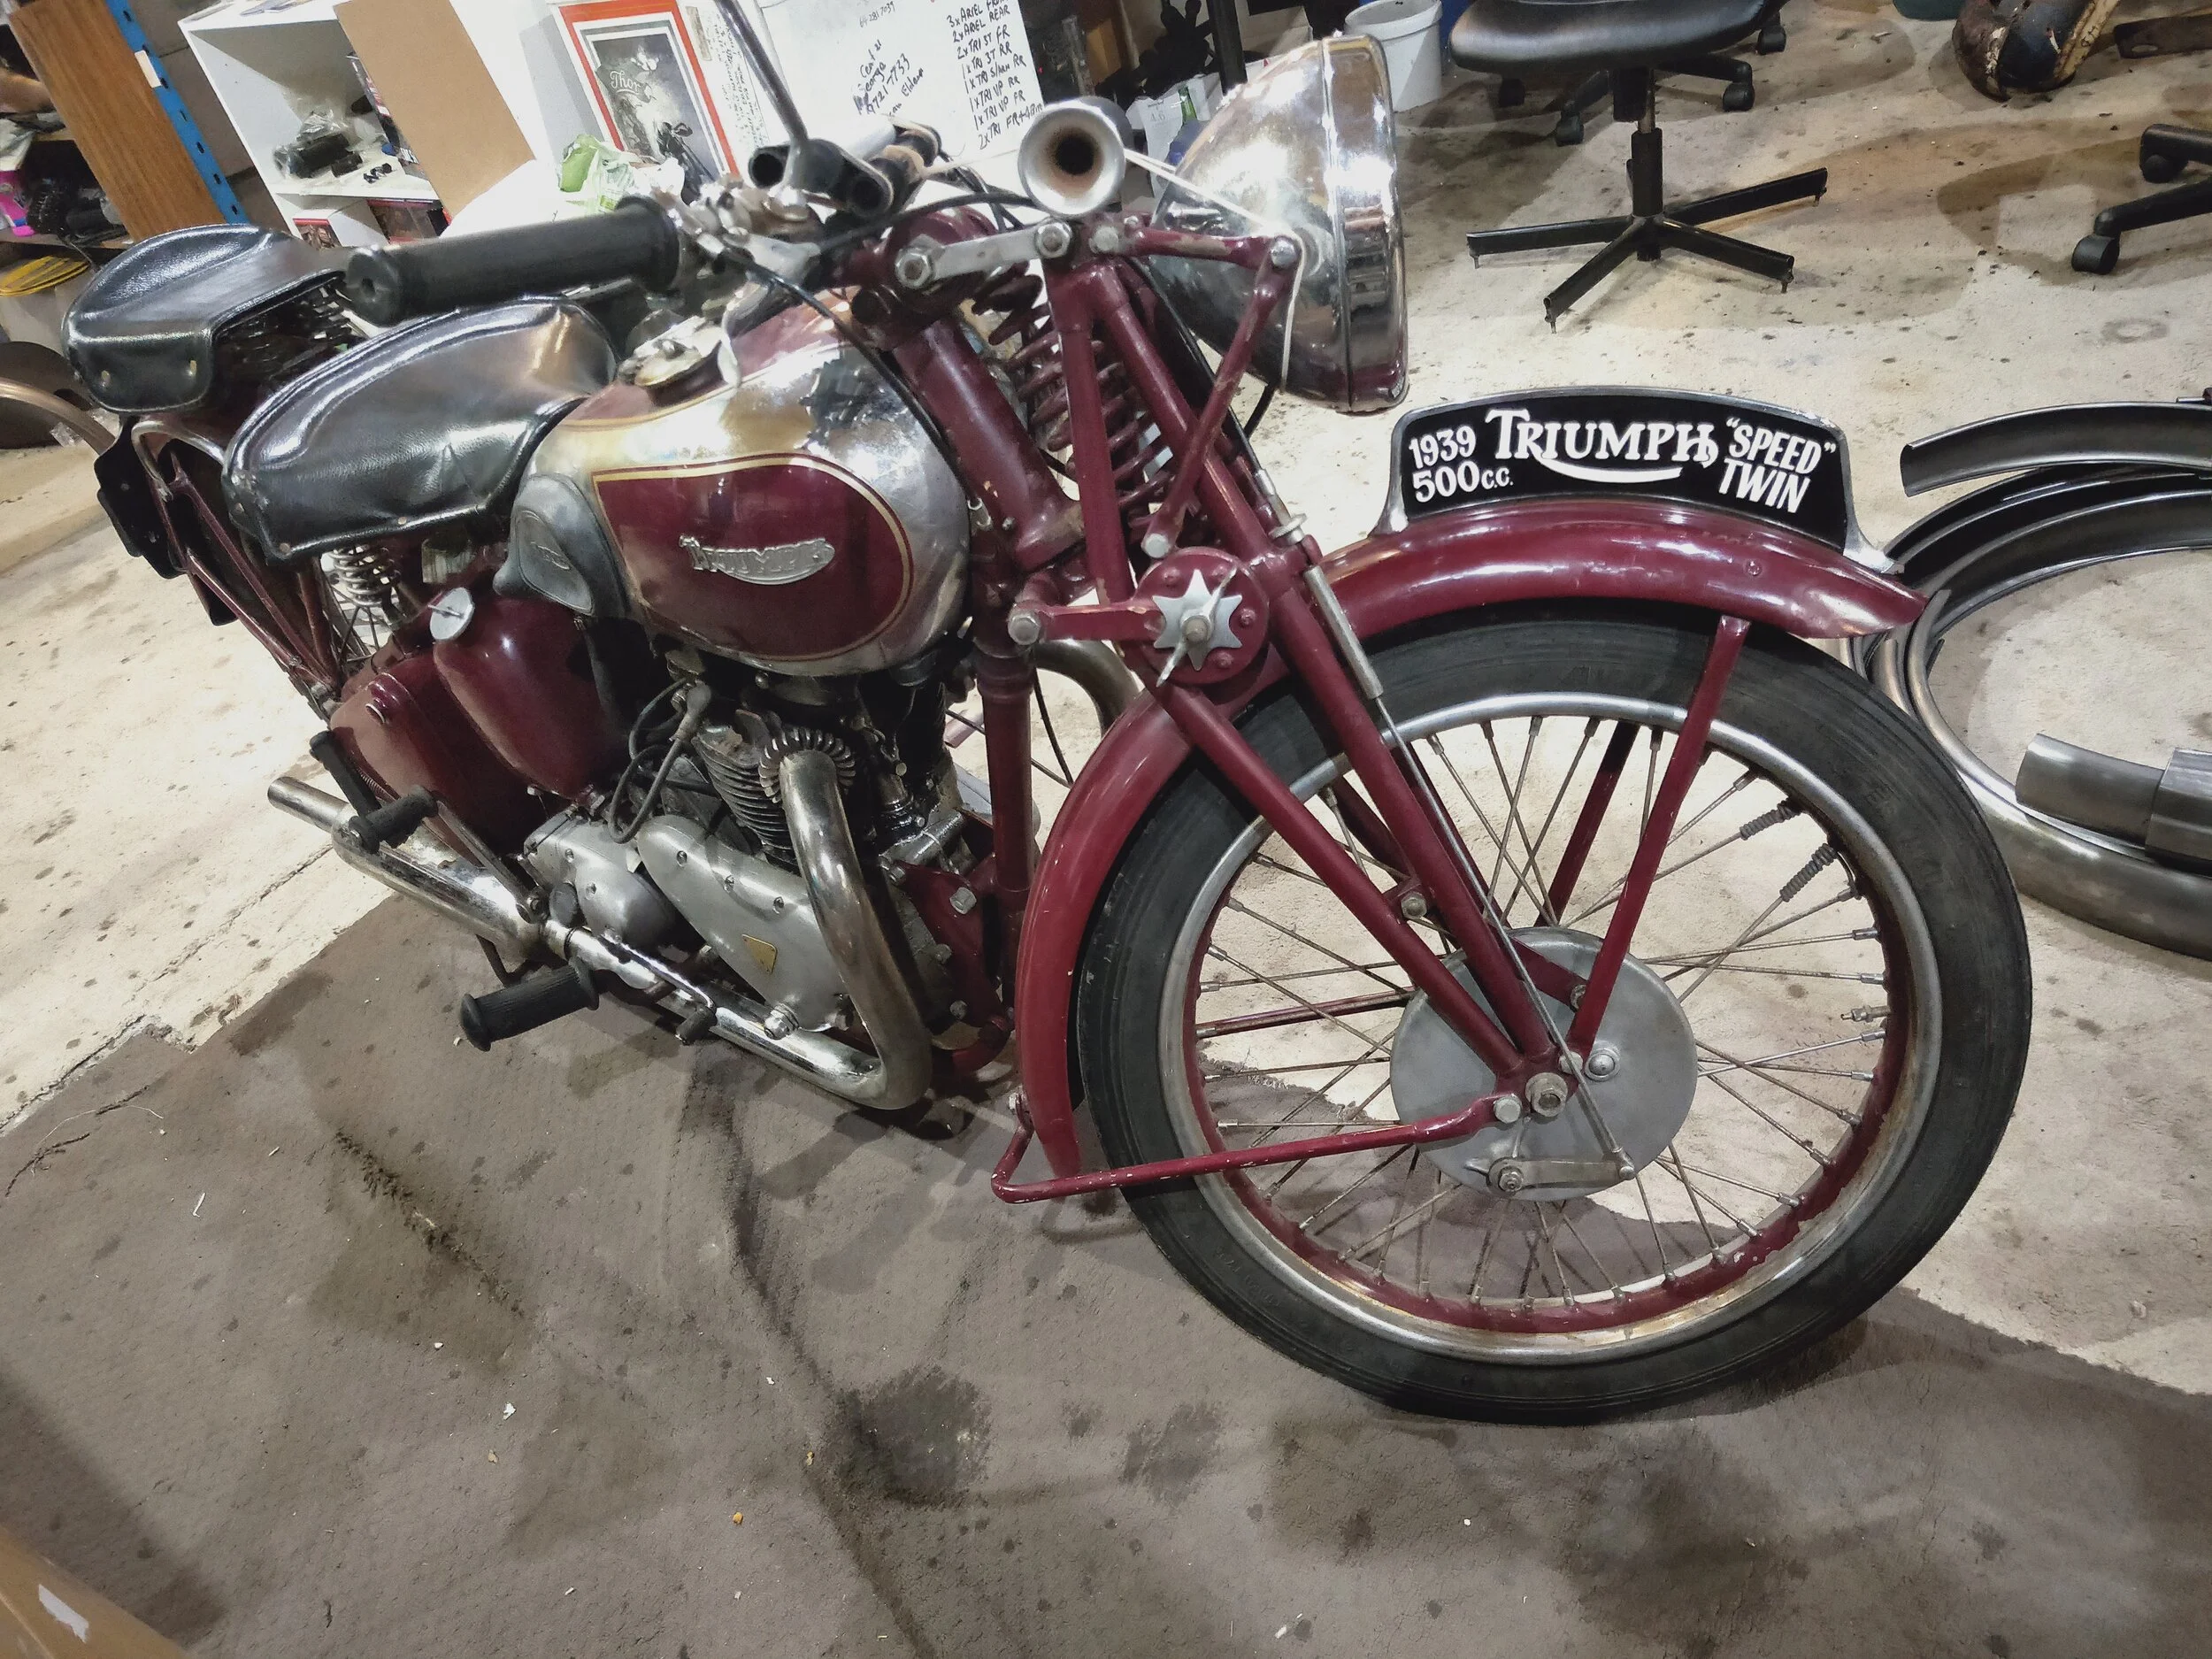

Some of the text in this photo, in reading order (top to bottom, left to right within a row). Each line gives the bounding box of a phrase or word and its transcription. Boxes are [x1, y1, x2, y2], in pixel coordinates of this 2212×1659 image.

[986, 0, 1009, 11] FRO
[988, 4, 1010, 23] REAR
[996, 24, 1010, 44] FR
[999, 41, 1012, 57] RR
[1012, 53, 1026, 68] RR
[610, 70, 641, 94] Thor
[1007, 75, 1021, 88] RR
[1408, 425, 1478, 470] 1939
[1484, 407, 1719, 483] TRIUMPH
[1725, 417, 1838, 475] "SPEED"
[1718, 457, 1812, 514] TWIN
